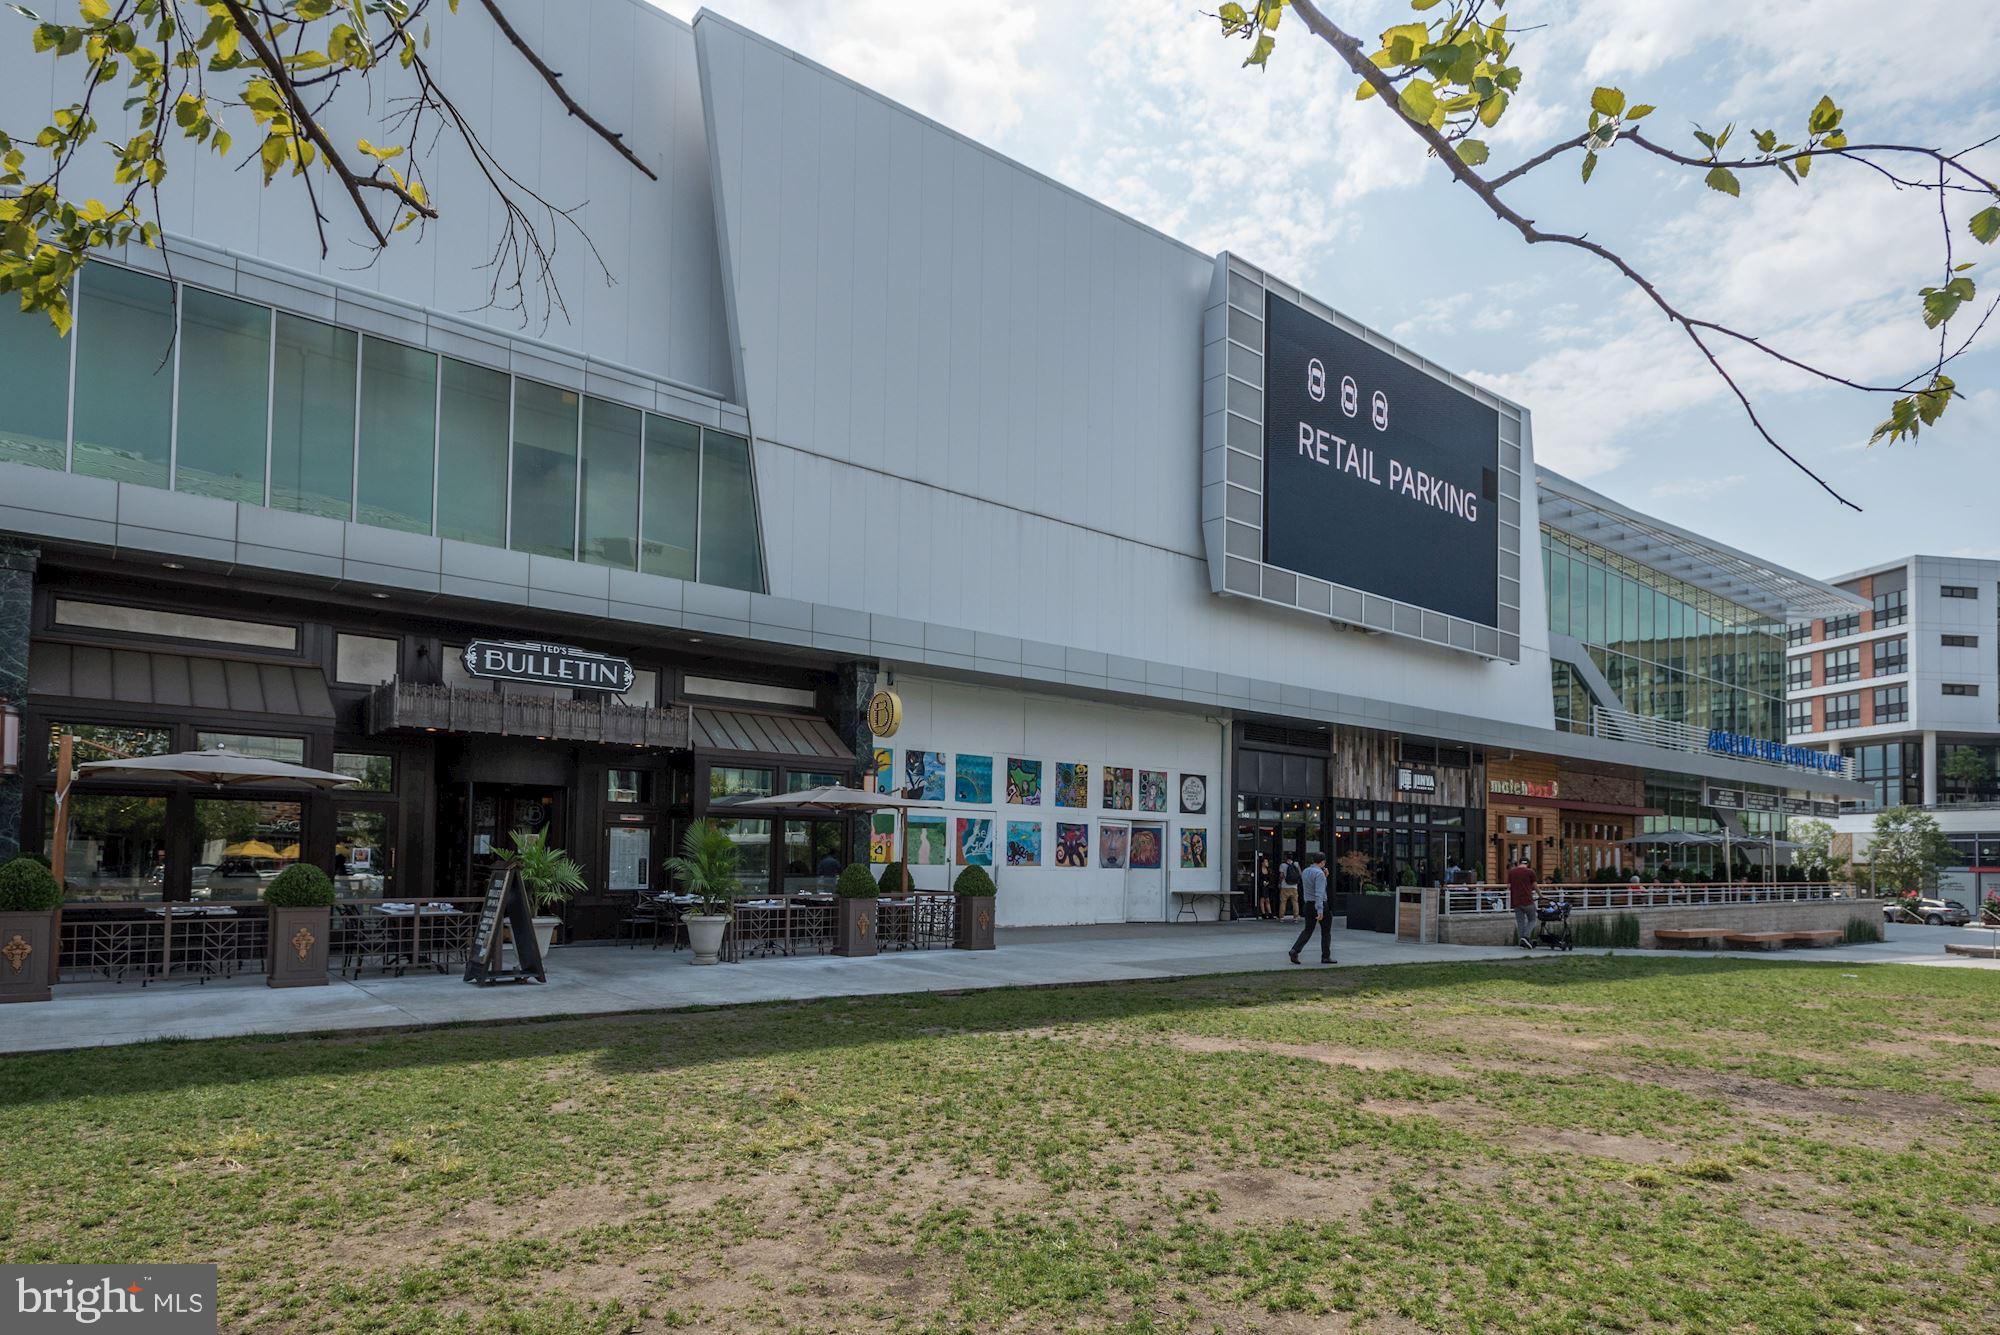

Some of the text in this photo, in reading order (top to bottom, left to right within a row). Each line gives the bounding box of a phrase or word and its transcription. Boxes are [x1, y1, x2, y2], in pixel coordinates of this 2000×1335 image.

[1299, 421, 1477, 522] RETAIL PARKING
[542, 644, 567, 655] TED'S
[484, 650, 618, 684] BULLETIN
[1708, 730, 1757, 756] ANGELIKA
[1413, 774, 1435, 789] JINYA
